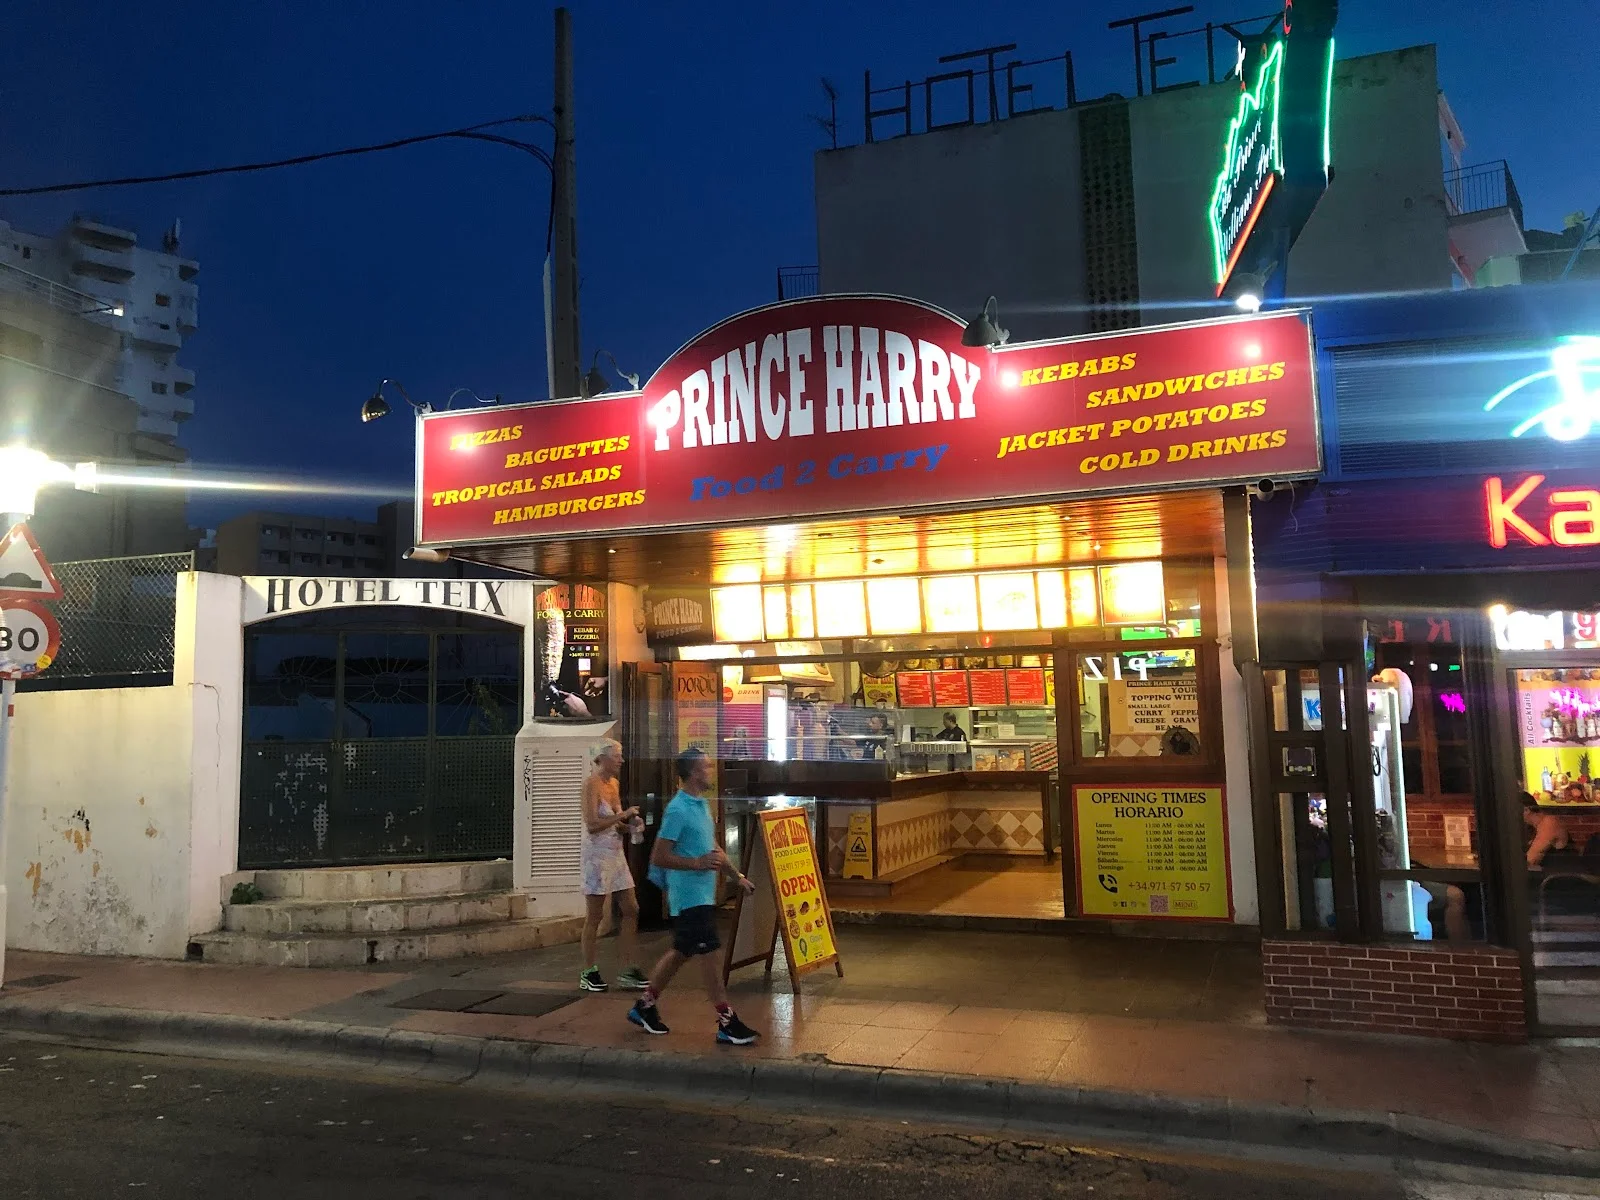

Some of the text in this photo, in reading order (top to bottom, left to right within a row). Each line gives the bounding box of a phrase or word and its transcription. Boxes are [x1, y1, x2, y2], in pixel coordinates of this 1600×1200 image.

[865, 43, 1106, 143] HOTEL
[1020, 352, 1137, 387] KEBABS
[1086, 362, 1285, 409] SANDWICHES
[650, 325, 981, 452] PRINCE HARRY
[450, 425, 524, 451] PIZZAS
[997, 398, 1267, 459] JACKET POTATOES
[505, 435, 630, 469] BAGUETTES
[1079, 429, 1288, 474] COLD DRINKS
[432, 465, 623, 507] TROPICAL SALADS
[690, 443, 950, 501] Food 2 Carry
[493, 489, 645, 525] HAMBURGERS
[266, 578, 506, 616] HOTEL TEIX
[566, 610, 572, 618] 2
[574, 609, 606, 618] CARRY
[0, 626, 40, 652] 30
[1524, 692, 1534, 731] Cocktails
[1091, 792, 1207, 804] OPENING TIMES
[1114, 806, 1184, 819] HORARIO
[774, 849, 789, 859] FOOD
[793, 846, 809, 855] CARRY
[781, 873, 817, 898] OPEN
[1170, 882, 1181, 891] 57
[1185, 882, 1196, 892] 50
[1199, 883, 1211, 892] 57
